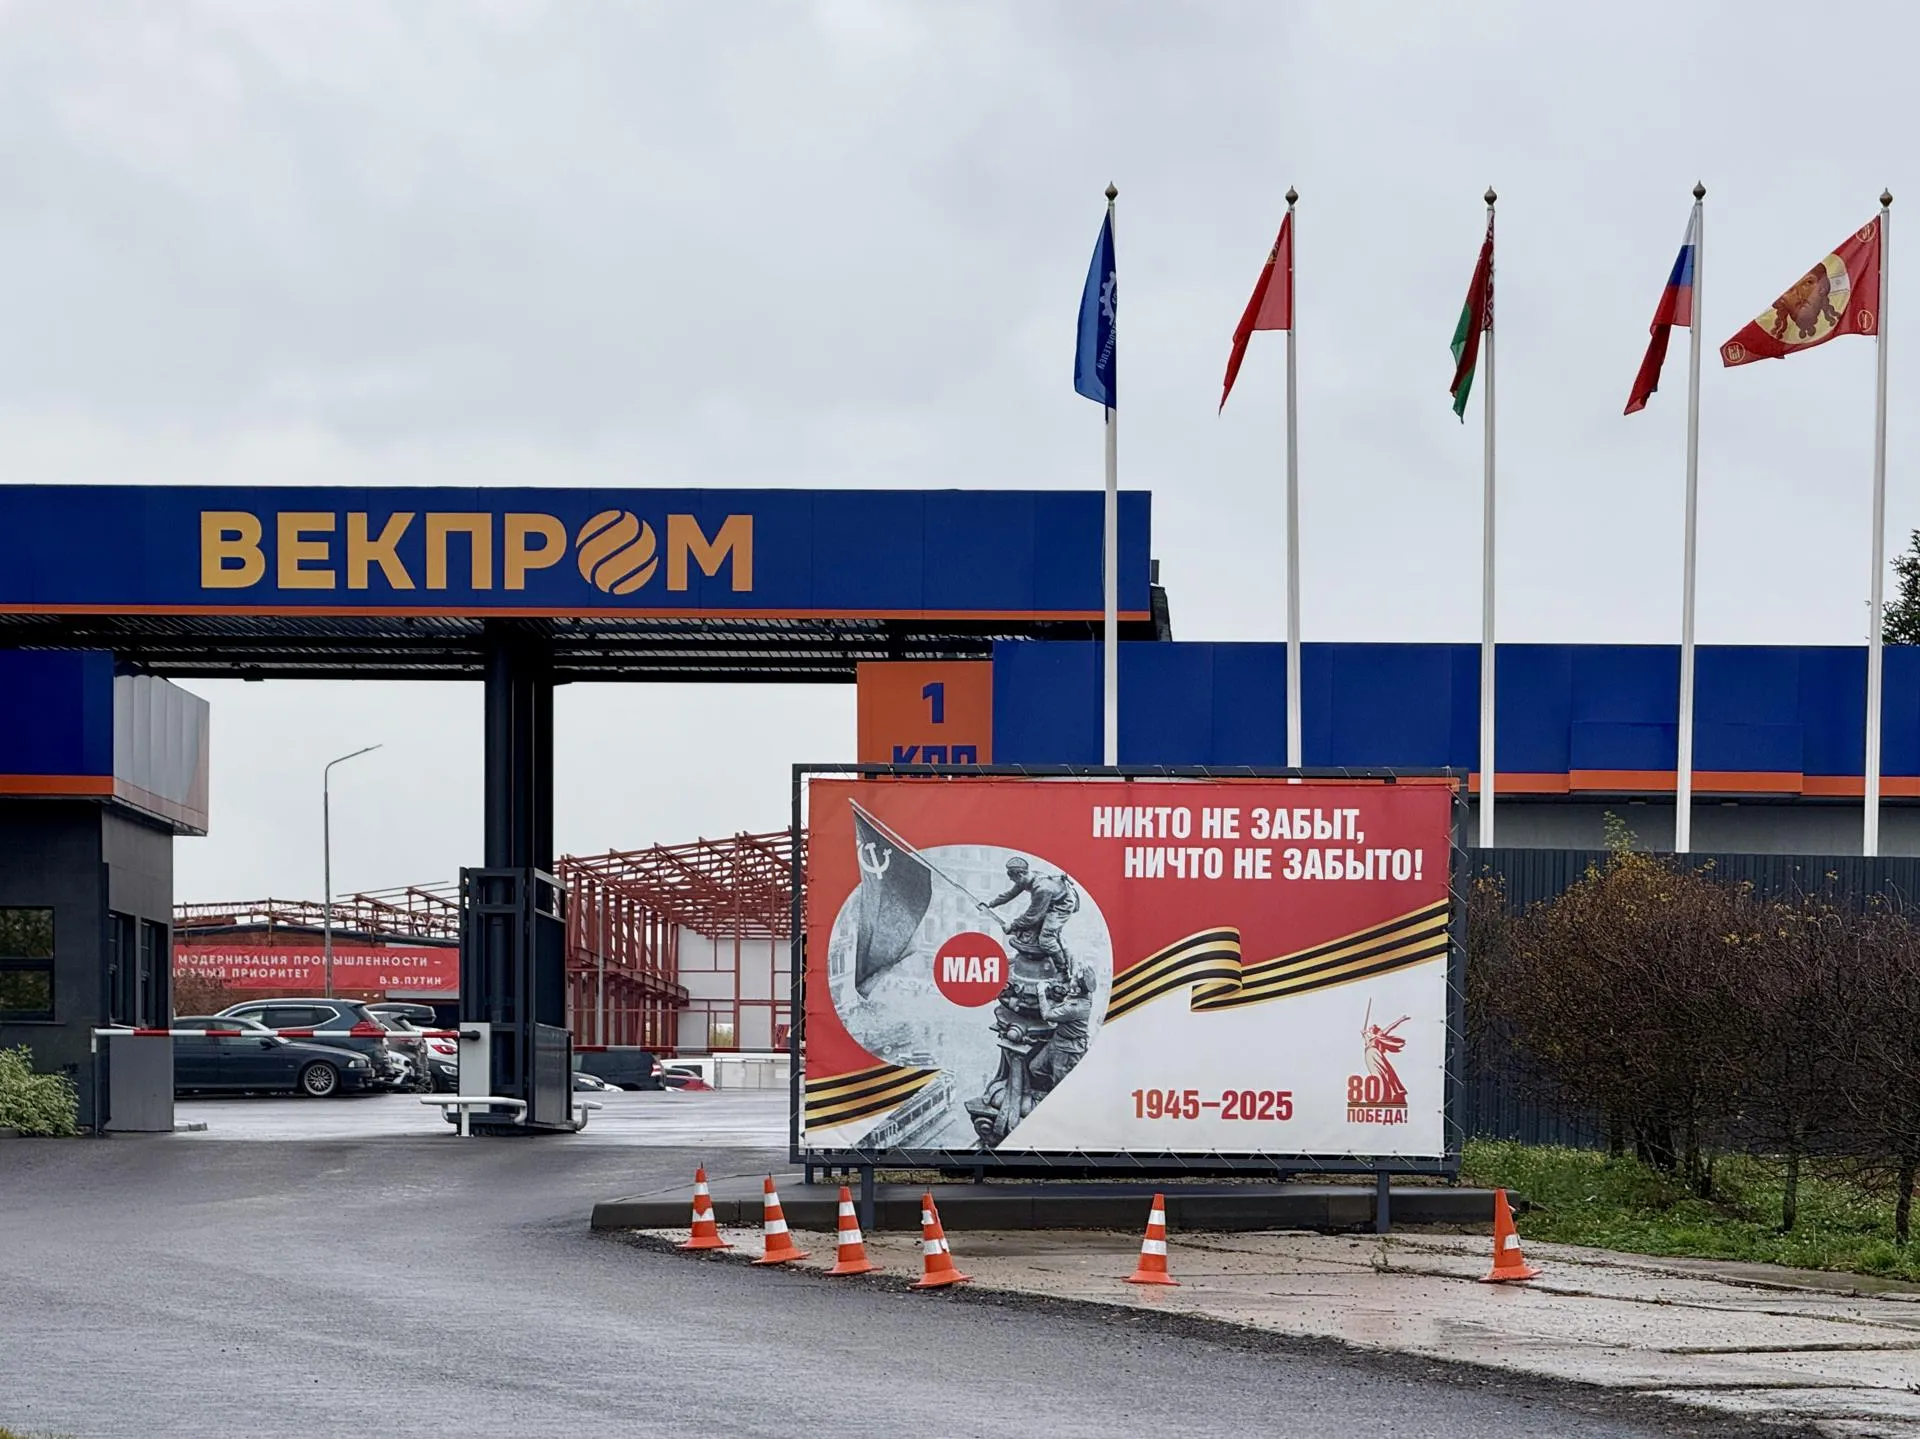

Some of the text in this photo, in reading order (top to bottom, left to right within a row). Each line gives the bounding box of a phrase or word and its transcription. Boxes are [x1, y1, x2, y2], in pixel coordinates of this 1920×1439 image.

[201, 509, 753, 596] ВЕКПРОМ
[922, 683, 944, 723] 1
[1092, 806, 1365, 844] НИКТО НЕ ЗАБЫТ,
[1124, 846, 1423, 881] НИЧТО НЕ ЗАБЫТО!
[178, 954, 289, 966] МОДЕРНИЗАЦИЯ
[231, 967, 310, 979] ПРИОРИТЕТ
[942, 956, 1000, 984] МАЯ
[1347, 1074, 1381, 1103] 80
[1131, 1089, 1293, 1121] 1945–2025
[1347, 1109, 1408, 1126] ПОБЕДА!
